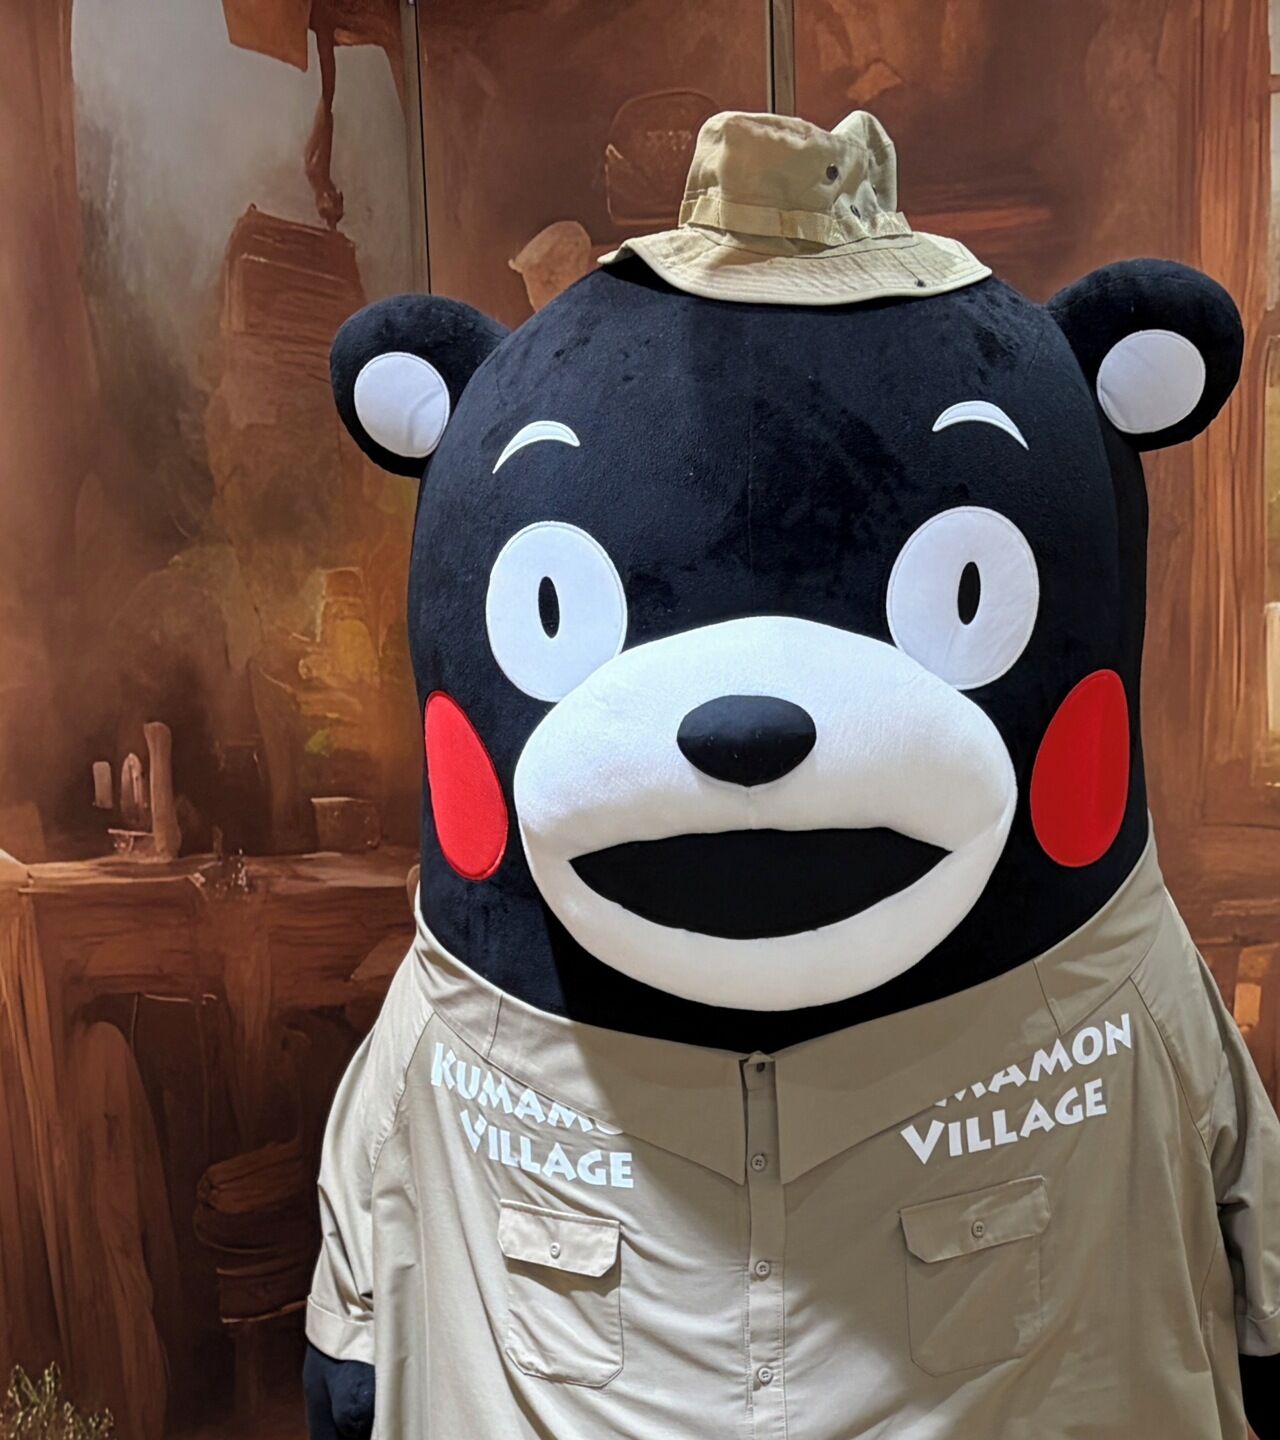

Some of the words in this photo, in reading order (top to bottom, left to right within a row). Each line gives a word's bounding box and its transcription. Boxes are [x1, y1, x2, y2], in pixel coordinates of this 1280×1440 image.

[431, 1042, 624, 1136] KUMAM
[934, 1013, 1132, 1107] AMON
[460, 1109, 634, 1189] VILLAGE
[900, 1078, 1107, 1165] VILLAGE
